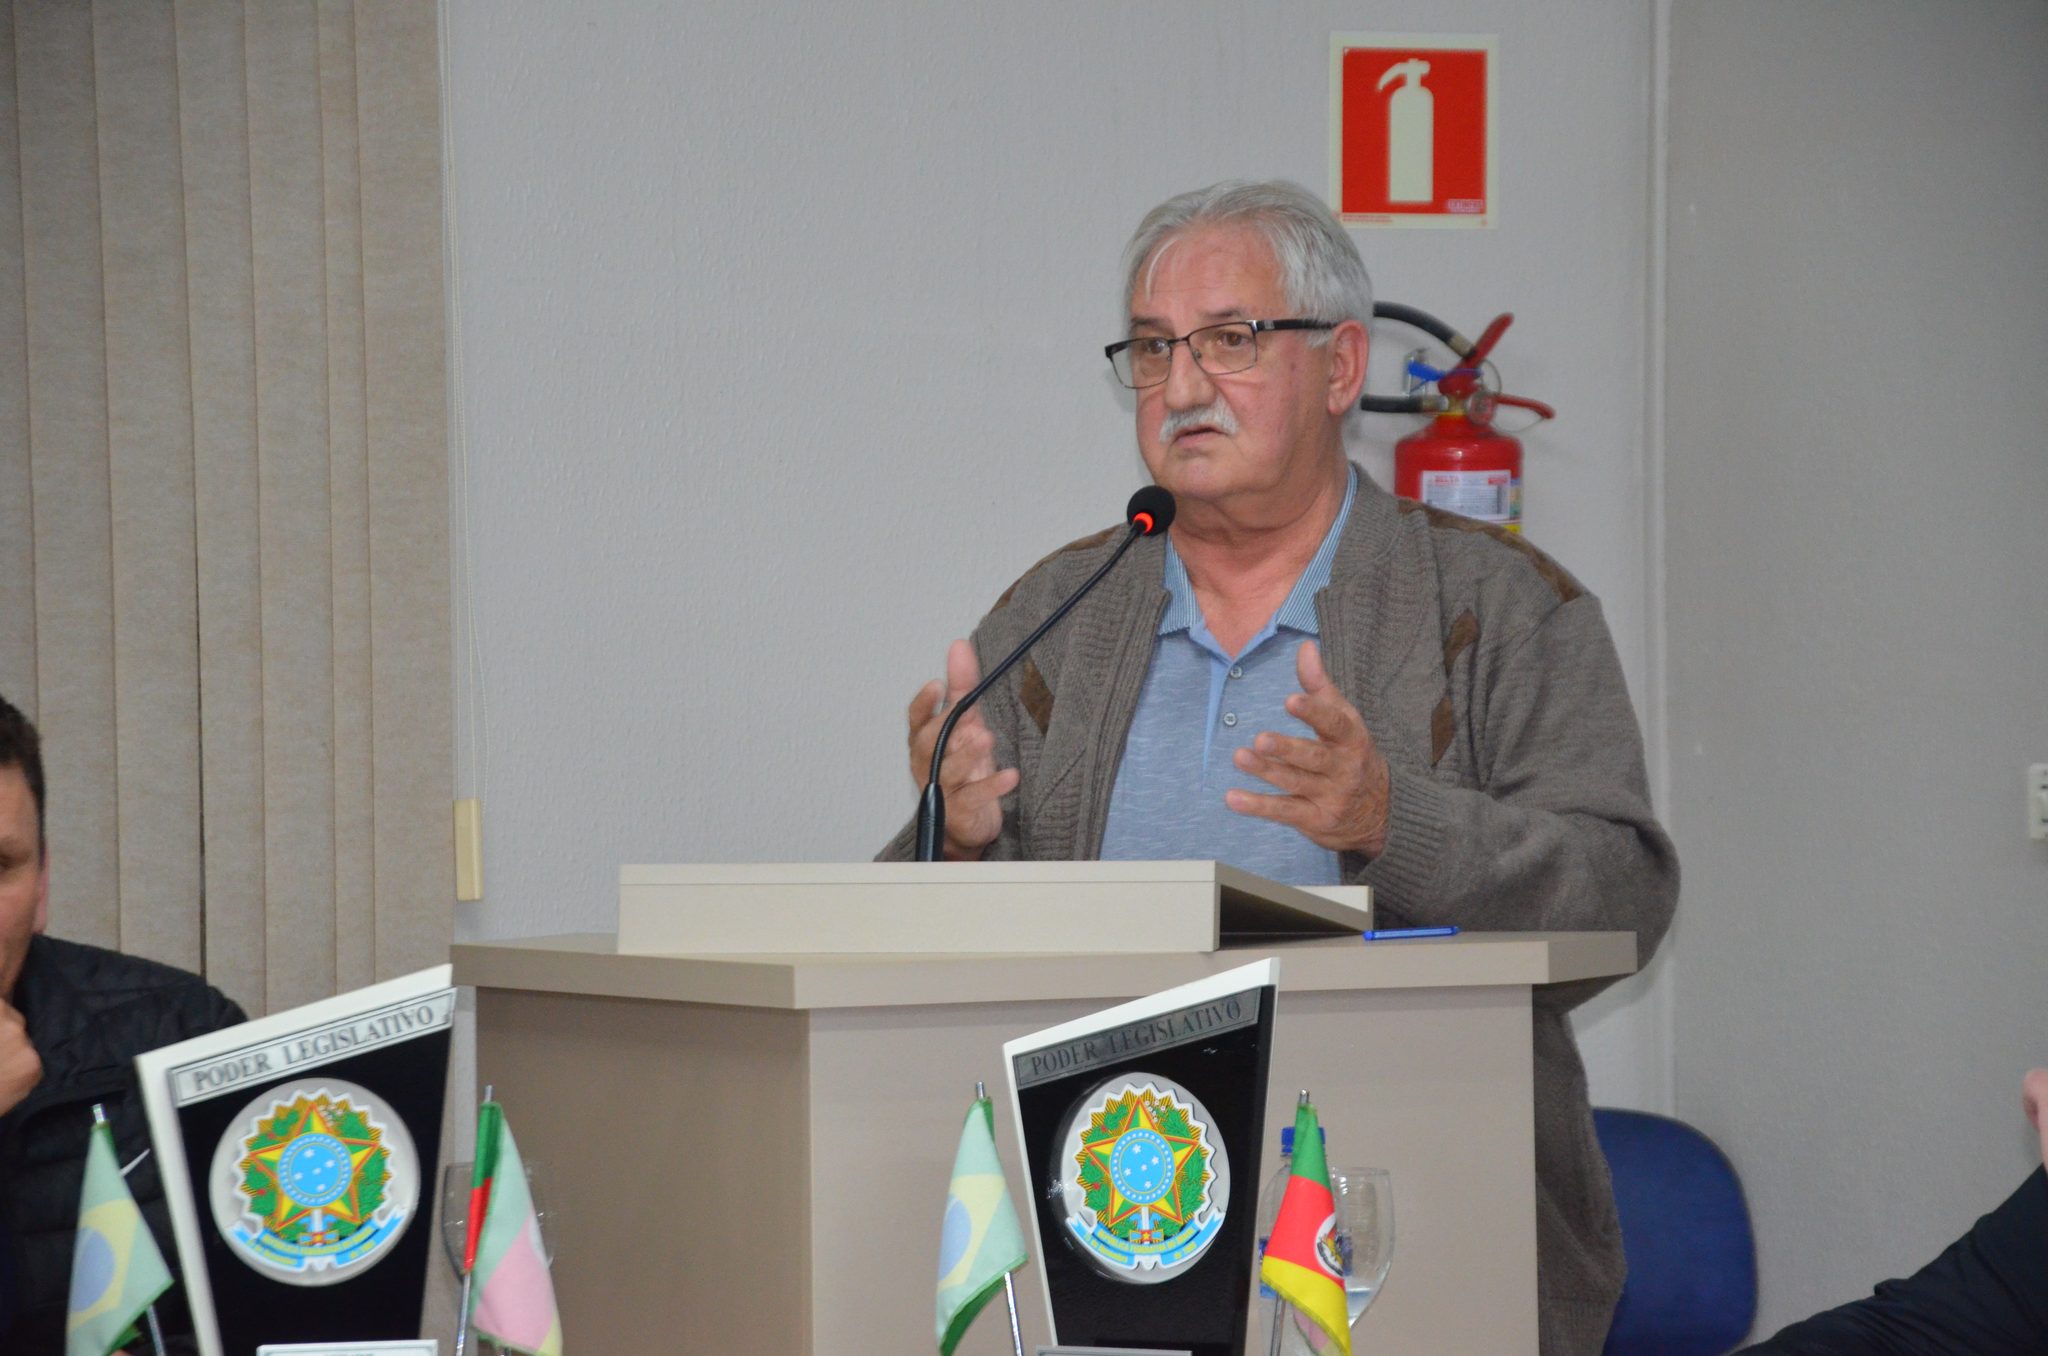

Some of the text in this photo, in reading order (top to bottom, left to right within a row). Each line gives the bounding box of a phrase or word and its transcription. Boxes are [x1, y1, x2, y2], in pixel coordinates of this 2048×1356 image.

[194, 1005, 433, 1091] PODER LEGISLATIVO
[1031, 1001, 1241, 1075] PODER LEGISLATIVO
